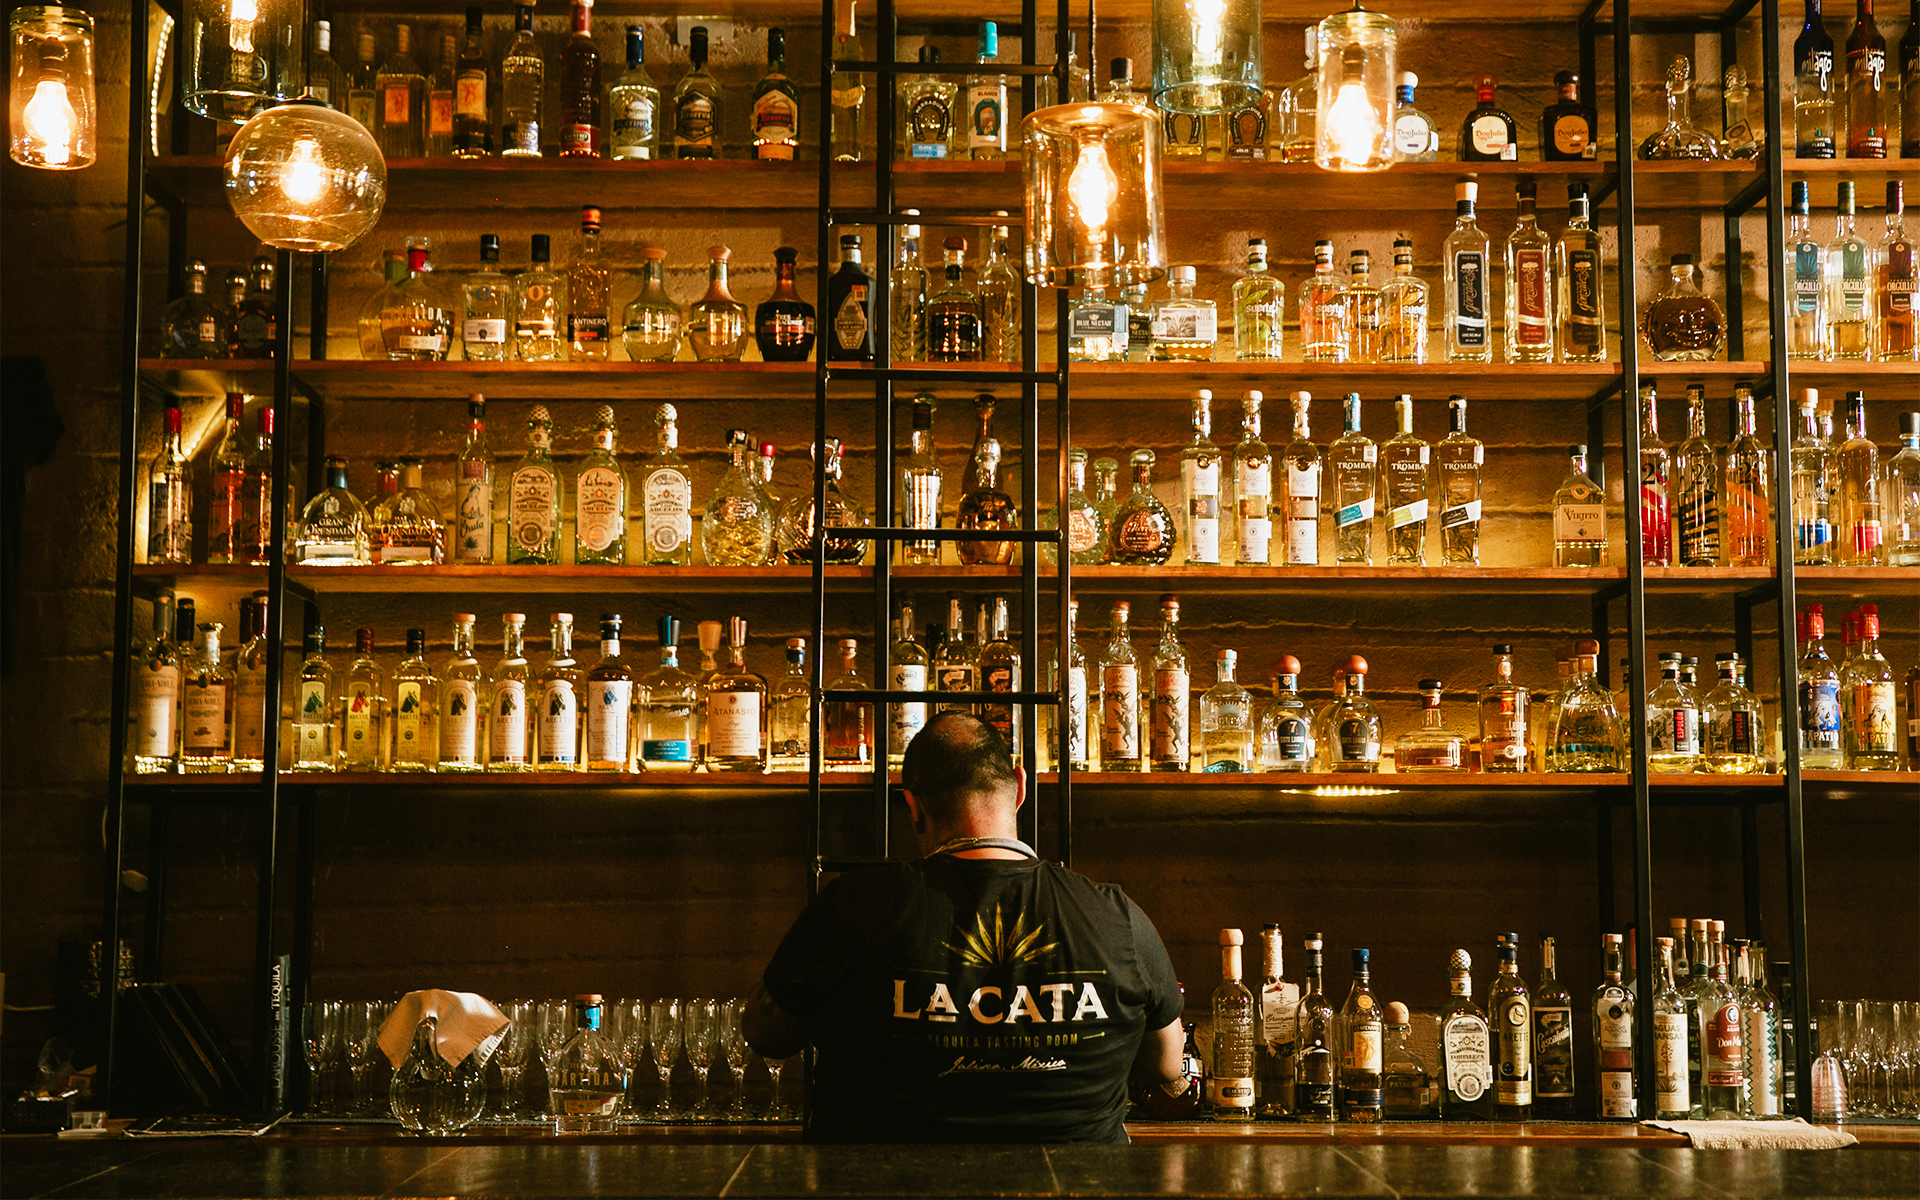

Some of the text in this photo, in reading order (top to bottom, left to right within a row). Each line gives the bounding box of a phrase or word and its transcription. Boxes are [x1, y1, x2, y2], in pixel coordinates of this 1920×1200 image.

[1802, 47, 1832, 92] milagro
[1855, 46, 1885, 92] milagro
[915, 100, 946, 114] HERRADURA
[1794, 281, 1821, 291] ORGULLO
[1841, 281, 1868, 291] ORGULLO
[1887, 281, 1915, 291] ORGULLO
[569, 317, 607, 326] CANTINERO
[1337, 462, 1371, 470] TROMBA
[1391, 463, 1426, 471] TROMBA
[1566, 512, 1599, 521] VIEJITO
[319, 518, 343, 526] GRAN
[713, 708, 756, 716] ATANASIO
[1289, 721, 1298, 733] 7
[1351, 722, 1359, 734] 7
[1803, 731, 1839, 742] TAPATIO
[271, 964, 282, 1009] TEQUILA
[893, 979, 1109, 1025] LA CATA
[928, 1032, 1078, 1049] TEQUILA TASTING ROOM
[1503, 1032, 1529, 1042] ARETTE
[1716, 1037, 1731, 1048] Don
